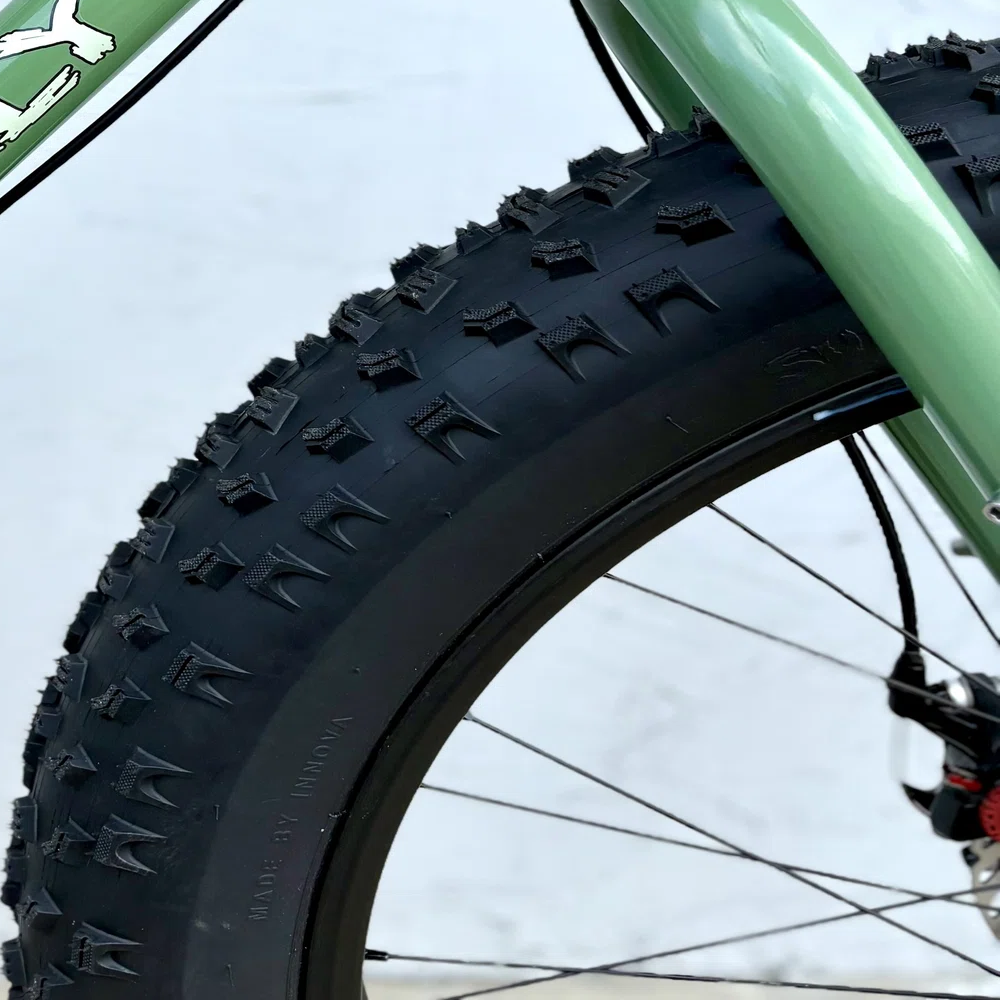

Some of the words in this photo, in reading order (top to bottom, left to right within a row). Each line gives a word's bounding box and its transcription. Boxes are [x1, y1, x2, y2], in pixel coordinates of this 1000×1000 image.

[248, 859, 283, 920] MADE
[273, 813, 298, 841] BY
[290, 716, 353, 797] INNOVA
